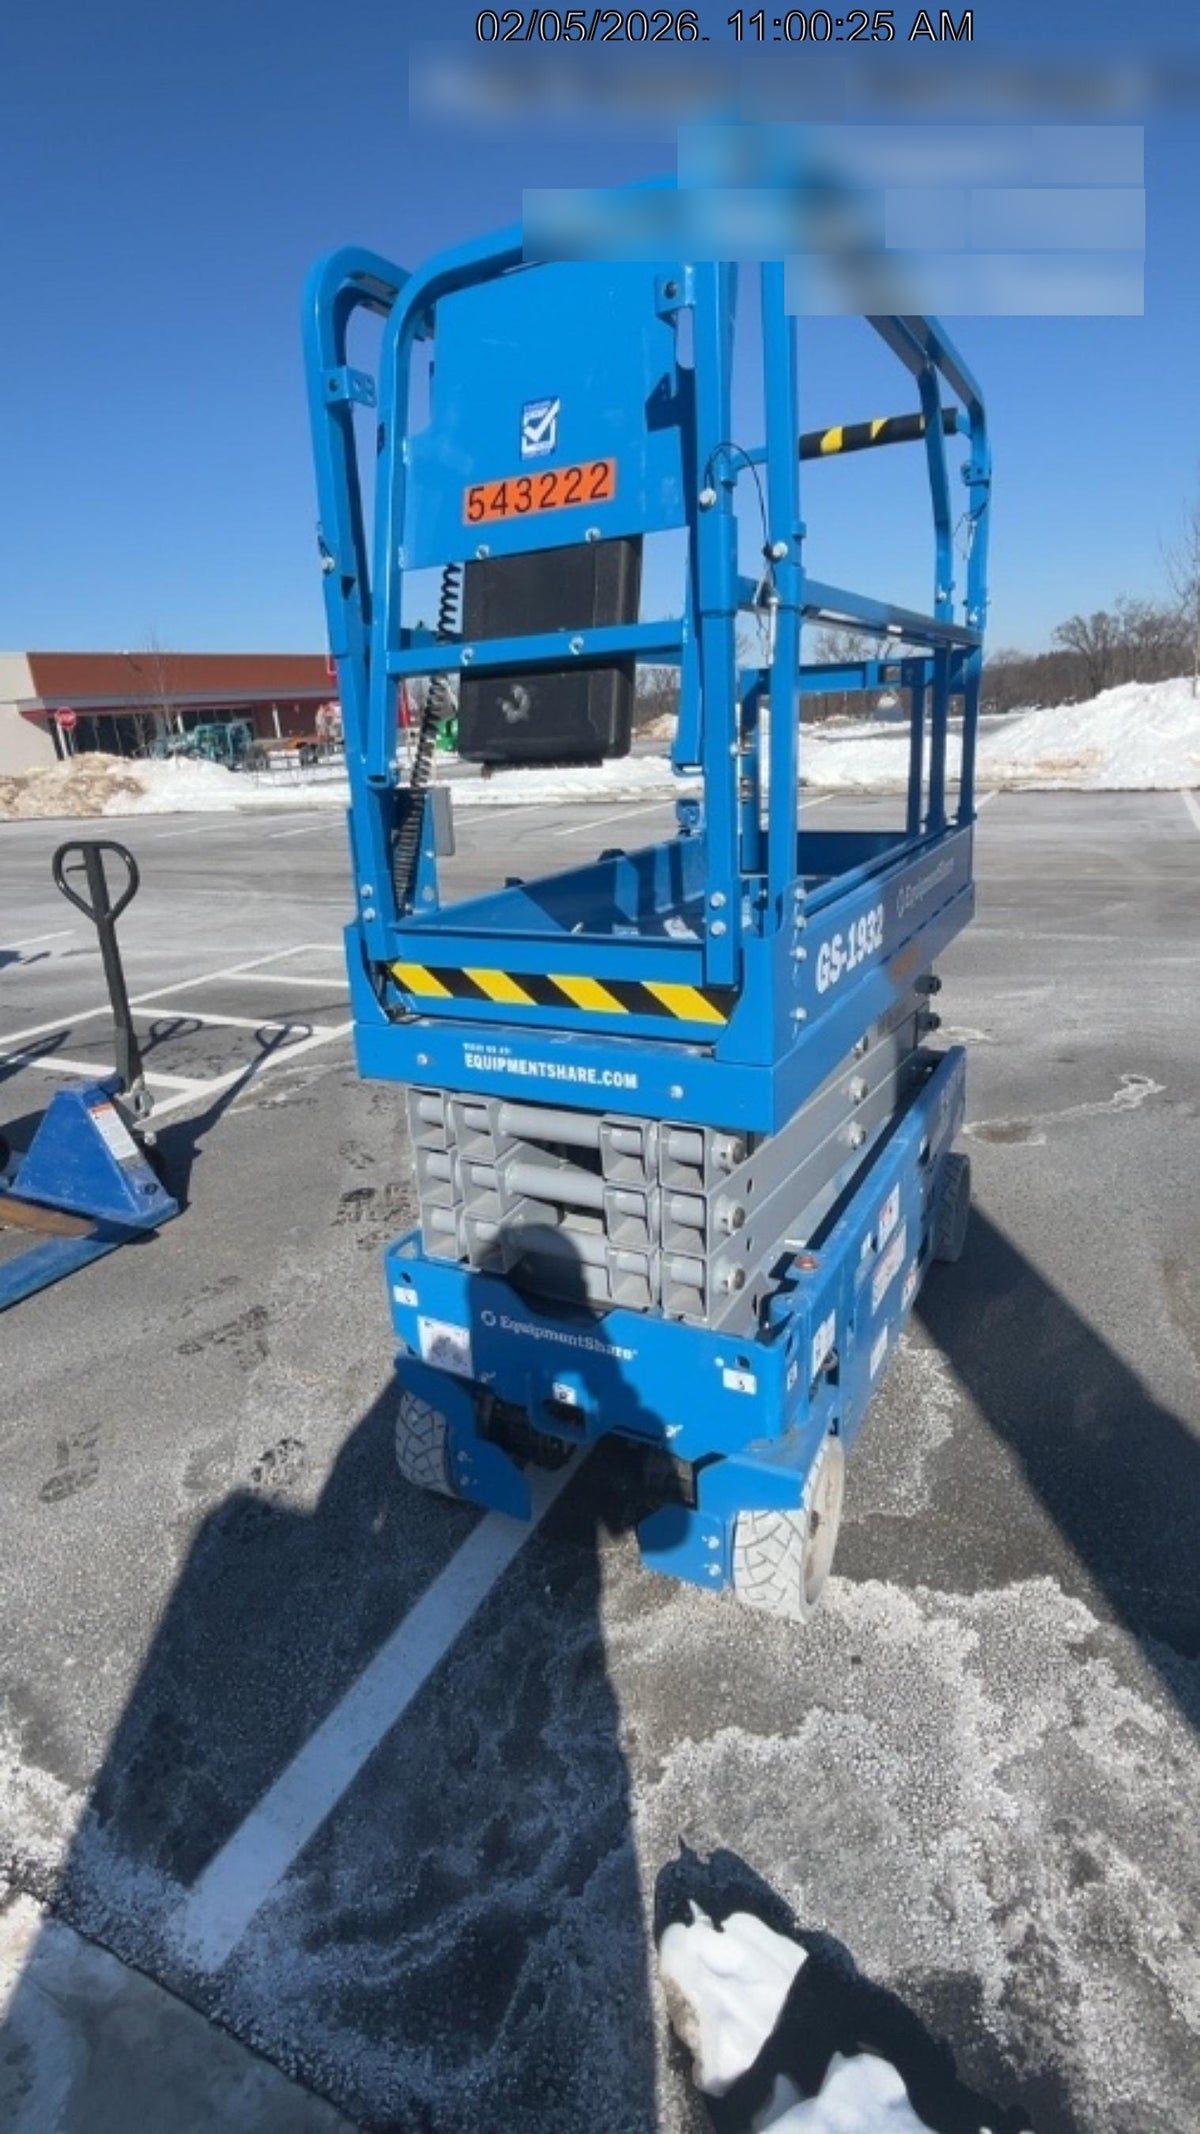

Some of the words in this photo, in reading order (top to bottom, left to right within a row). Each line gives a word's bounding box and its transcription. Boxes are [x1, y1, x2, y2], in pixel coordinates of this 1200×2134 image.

[467, 461, 609, 522] 543222
[815, 902, 884, 994] GS-1932
[464, 1052, 638, 1089] EQUIPMENTSHARE.COM
[500, 1315, 633, 1360] EquipmentShare
